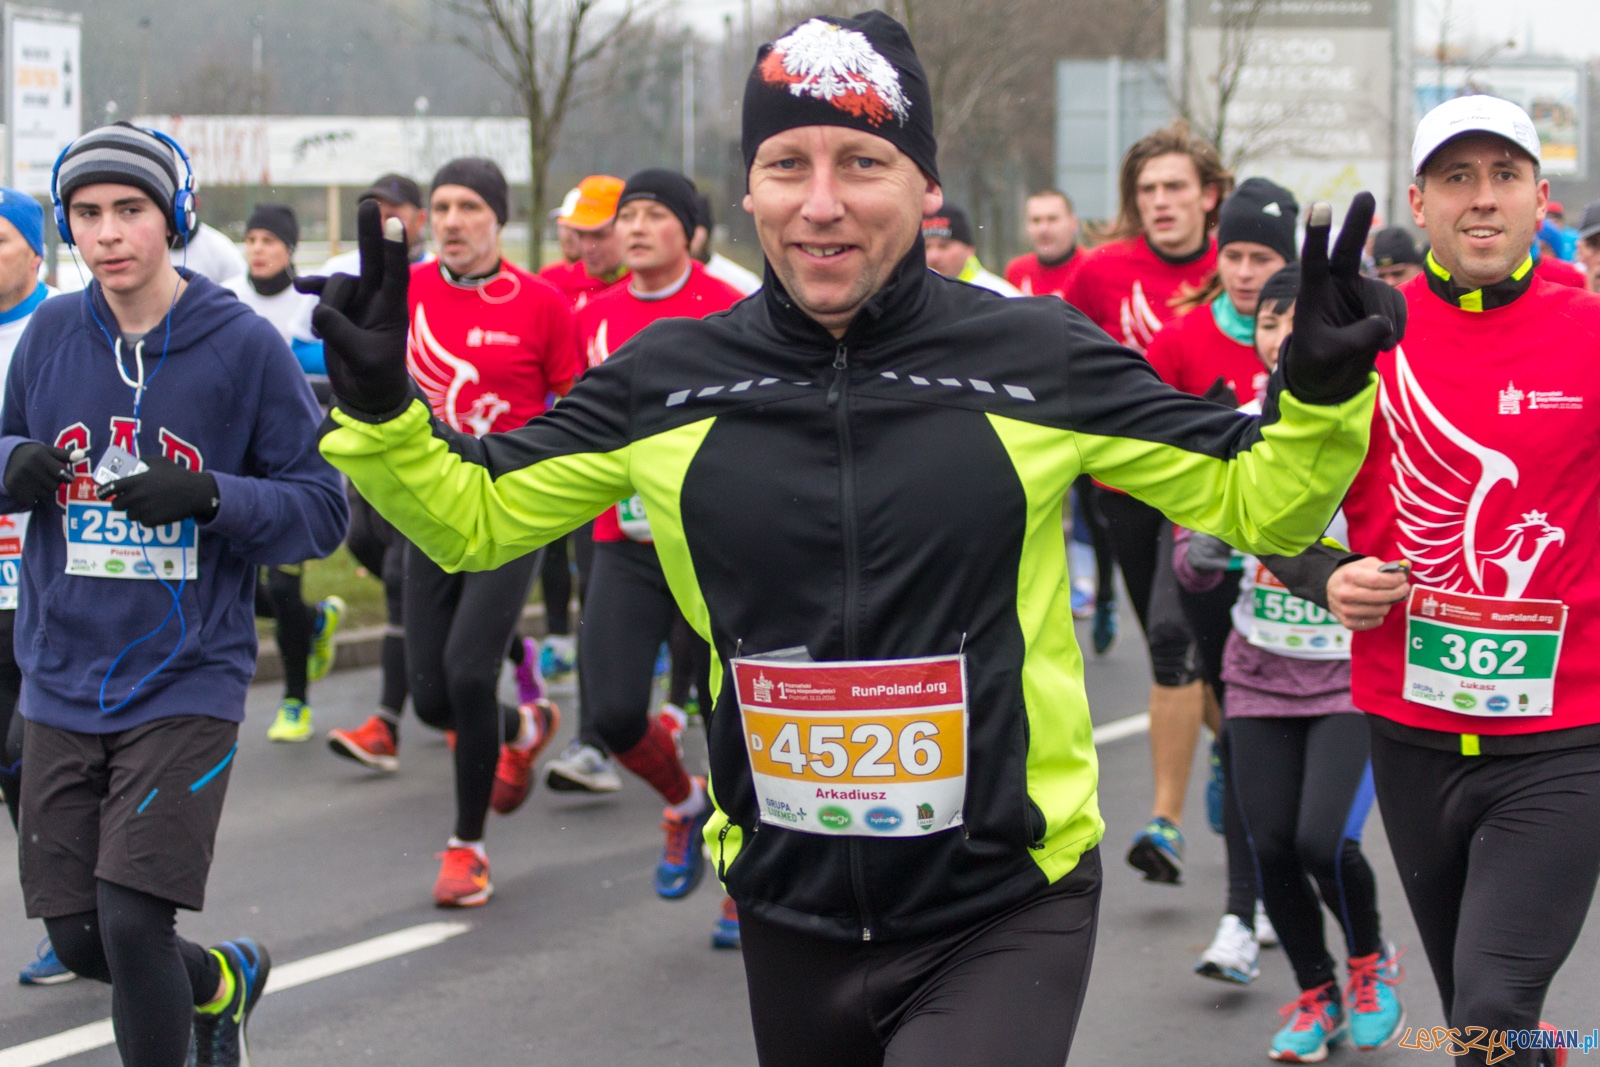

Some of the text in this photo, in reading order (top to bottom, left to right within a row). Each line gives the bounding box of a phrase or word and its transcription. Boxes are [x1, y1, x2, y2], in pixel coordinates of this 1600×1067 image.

[70, 517, 78, 530] E
[1263, 592, 1339, 624] 550
[1490, 612, 1554, 624] RunPoland.org
[1439, 633, 1528, 676] 362
[777, 681, 788, 700] 1
[851, 681, 947, 697] RunPoland.org
[1459, 680, 1497, 691] Łukasz
[750, 733, 764, 751] D
[769, 720, 943, 778] 4526
[815, 788, 887, 801] Arkadiusz
[765, 797, 791, 812] GRUPA
[767, 807, 798, 823] LUXMED
